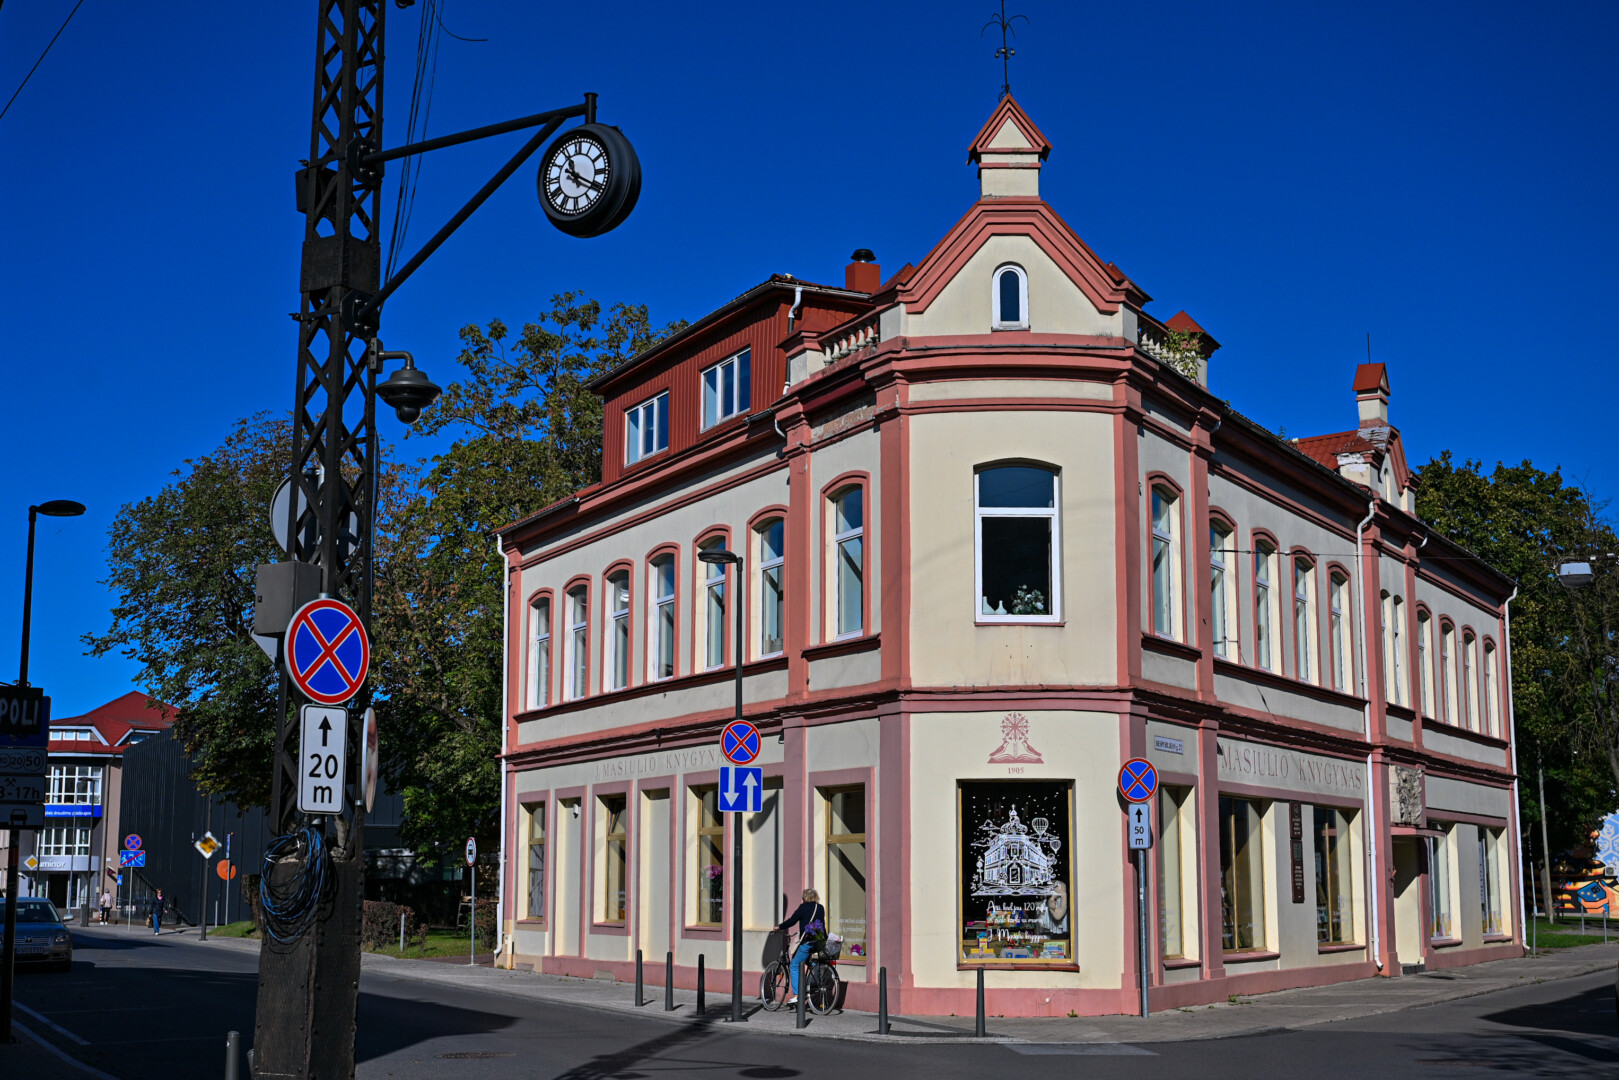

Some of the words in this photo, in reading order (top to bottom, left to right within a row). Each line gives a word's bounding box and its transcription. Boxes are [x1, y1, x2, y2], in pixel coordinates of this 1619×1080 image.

[10, 756, 22, 765] 20
[26, 756, 41, 766] 50
[309, 753, 338, 779] 20
[602, 756, 656, 778] MASIULIO
[665, 749, 724, 770] KNYGYNA
[1221, 744, 1289, 779] MASIULIO
[1299, 758, 1361, 790] KNYGYNAS
[313, 785, 332, 804] m
[1134, 825, 1145, 835] 50
[1135, 838, 1144, 846] m
[39, 859, 66, 868] uminor
[1024, 902, 1035, 911] 120
